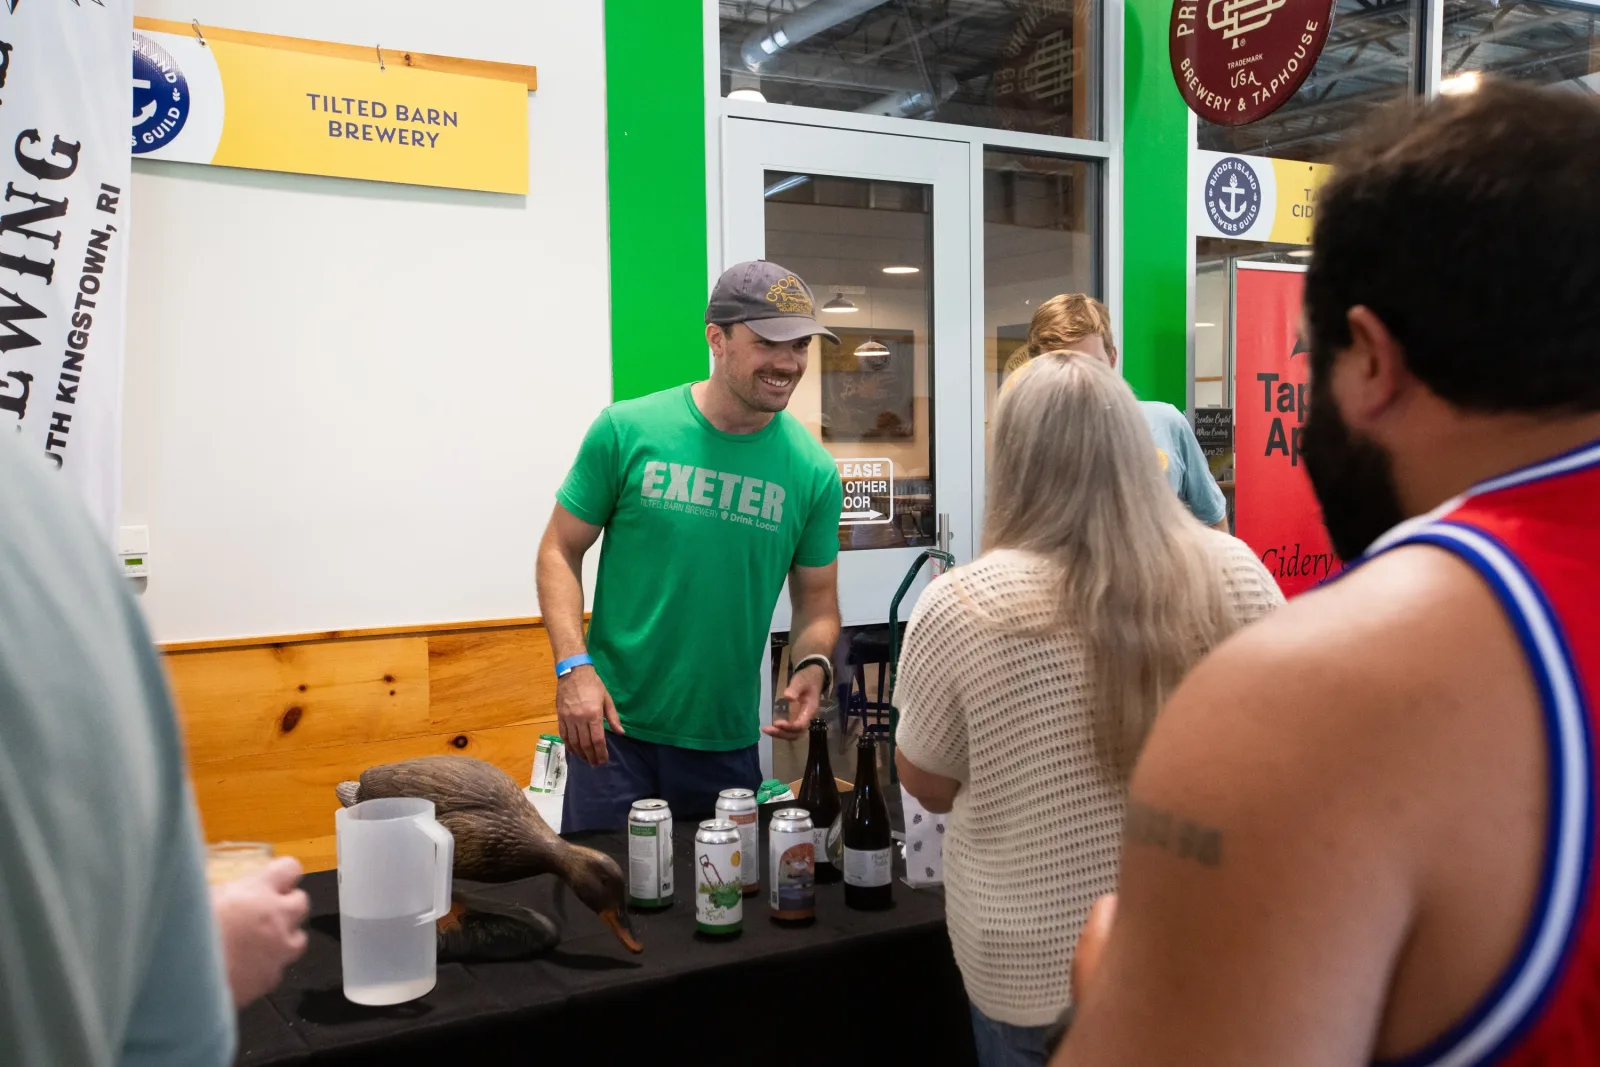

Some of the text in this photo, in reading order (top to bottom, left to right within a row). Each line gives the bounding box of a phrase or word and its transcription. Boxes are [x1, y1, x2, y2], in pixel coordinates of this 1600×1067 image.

[1176, 0, 1198, 38] PR
[1180, 57, 1232, 112] BREWERY
[1237, 97, 1246, 111] &
[1252, 19, 1319, 105] TAPHOUSE
[1227, 53, 1263, 69] TRADEMARK
[1230, 69, 1262, 89] USA
[142, 106, 181, 144] GUILD
[306, 92, 459, 128] TILTED BARN
[328, 119, 440, 149] BREWERY
[1209, 161, 1257, 190] RHODE ISLAND
[1208, 200, 1257, 232] BREWERS GUILD
[1292, 204, 1314, 218] CID
[56, 224, 117, 404] KINGSTOWN,
[96, 182, 121, 215] RI
[1257, 373, 1309, 423] Tap
[837, 463, 882, 478] EASE
[640, 461, 786, 523] EXETER
[843, 496, 871, 509] OOR
[845, 480, 887, 494] OTHER
[663, 501, 684, 512] BARN
[685, 505, 719, 518] BREWERY
[729, 513, 754, 526] Drink
[1261, 543, 1334, 585] Cidery
